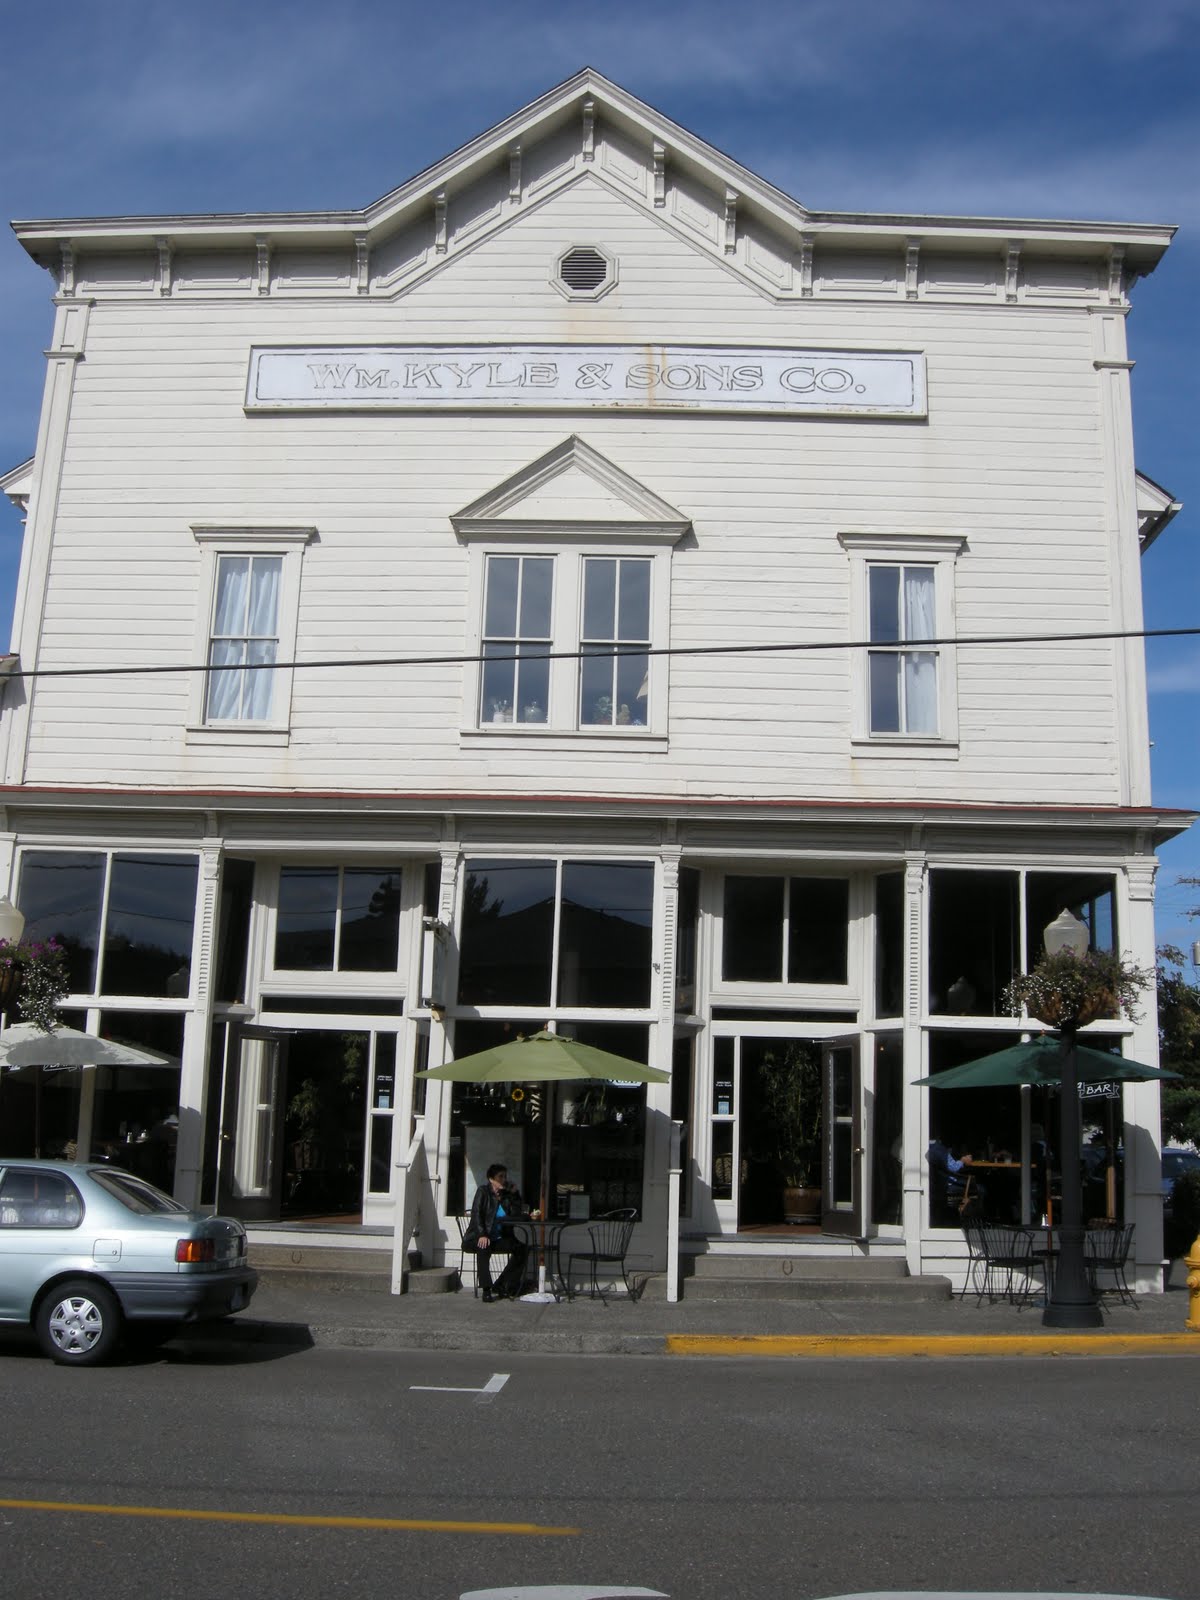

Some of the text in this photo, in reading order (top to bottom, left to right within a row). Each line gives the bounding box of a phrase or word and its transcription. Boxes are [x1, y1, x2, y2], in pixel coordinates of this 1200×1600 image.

[575, 363, 613, 390] &
[625, 364, 764, 391] SONS
[779, 366, 866, 394] CO.
[1086, 1083, 1111, 1095] BAR
